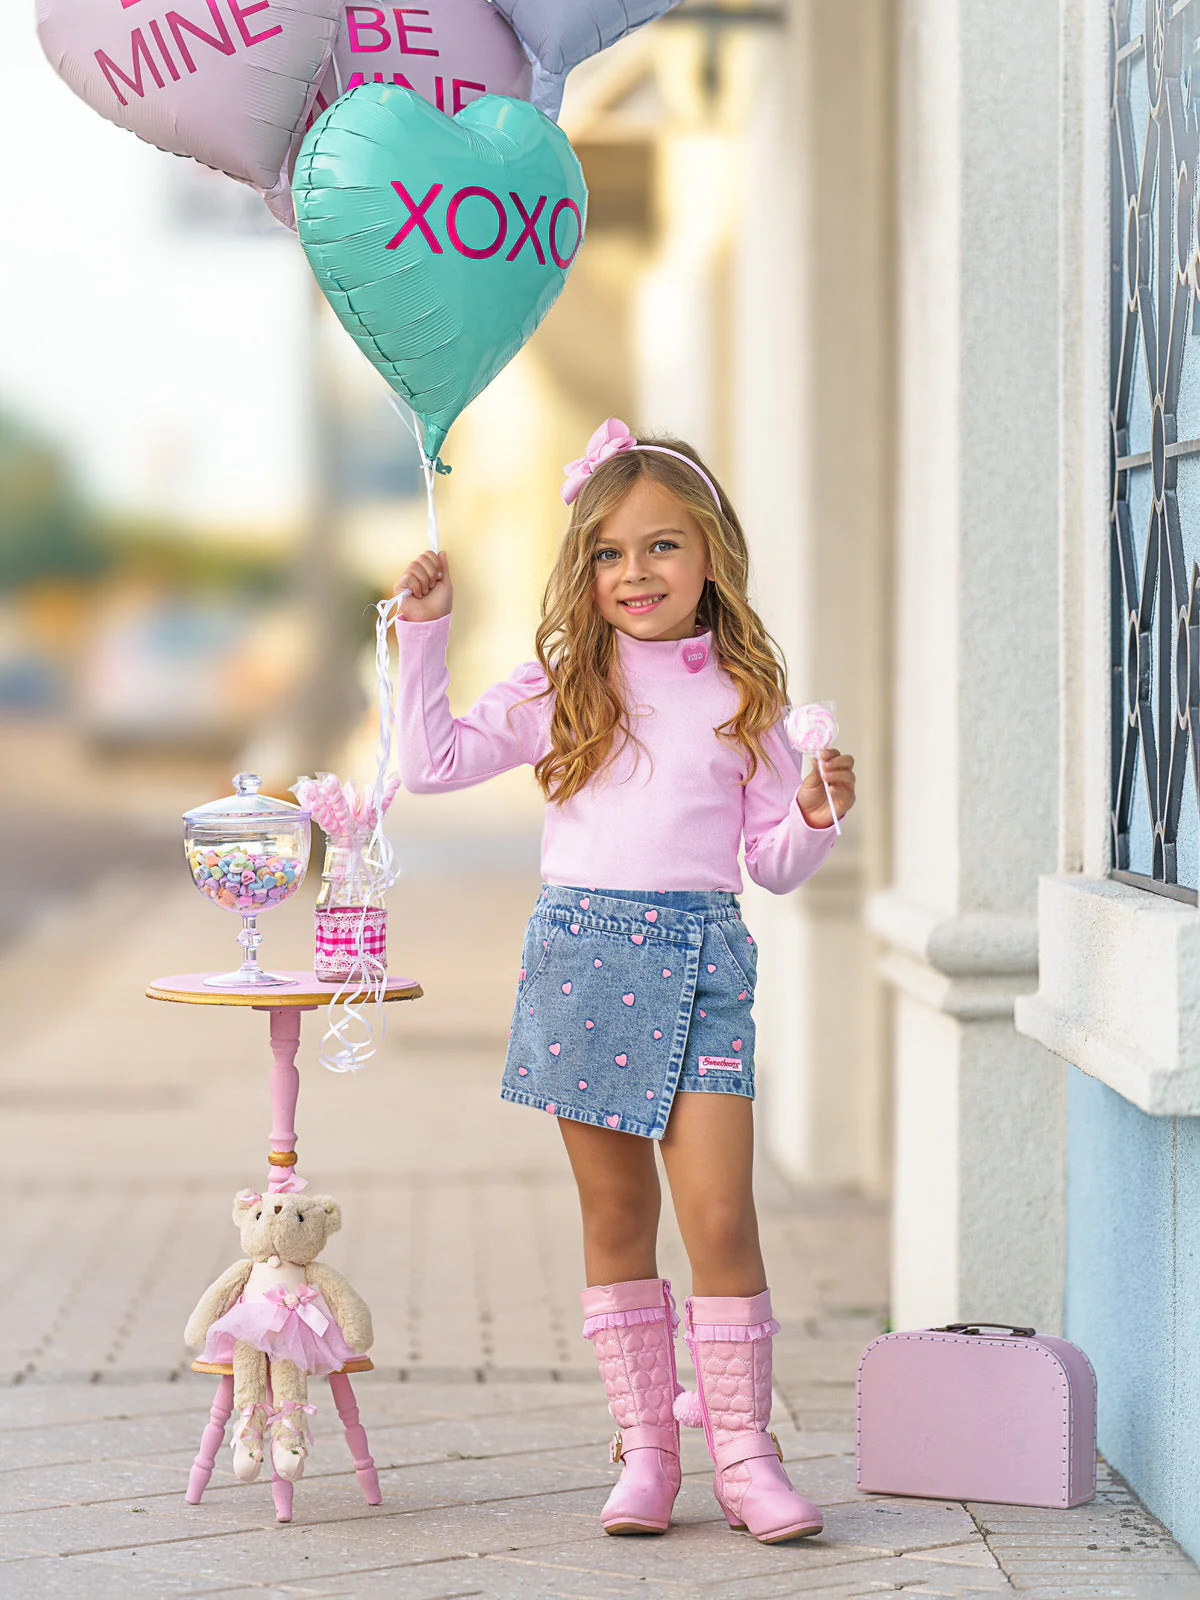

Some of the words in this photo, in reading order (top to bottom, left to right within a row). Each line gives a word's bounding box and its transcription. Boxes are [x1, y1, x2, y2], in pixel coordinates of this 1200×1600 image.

[94, 0, 283, 106] MINE
[345, 6, 439, 57] BE
[385, 181, 582, 269] XOXO
